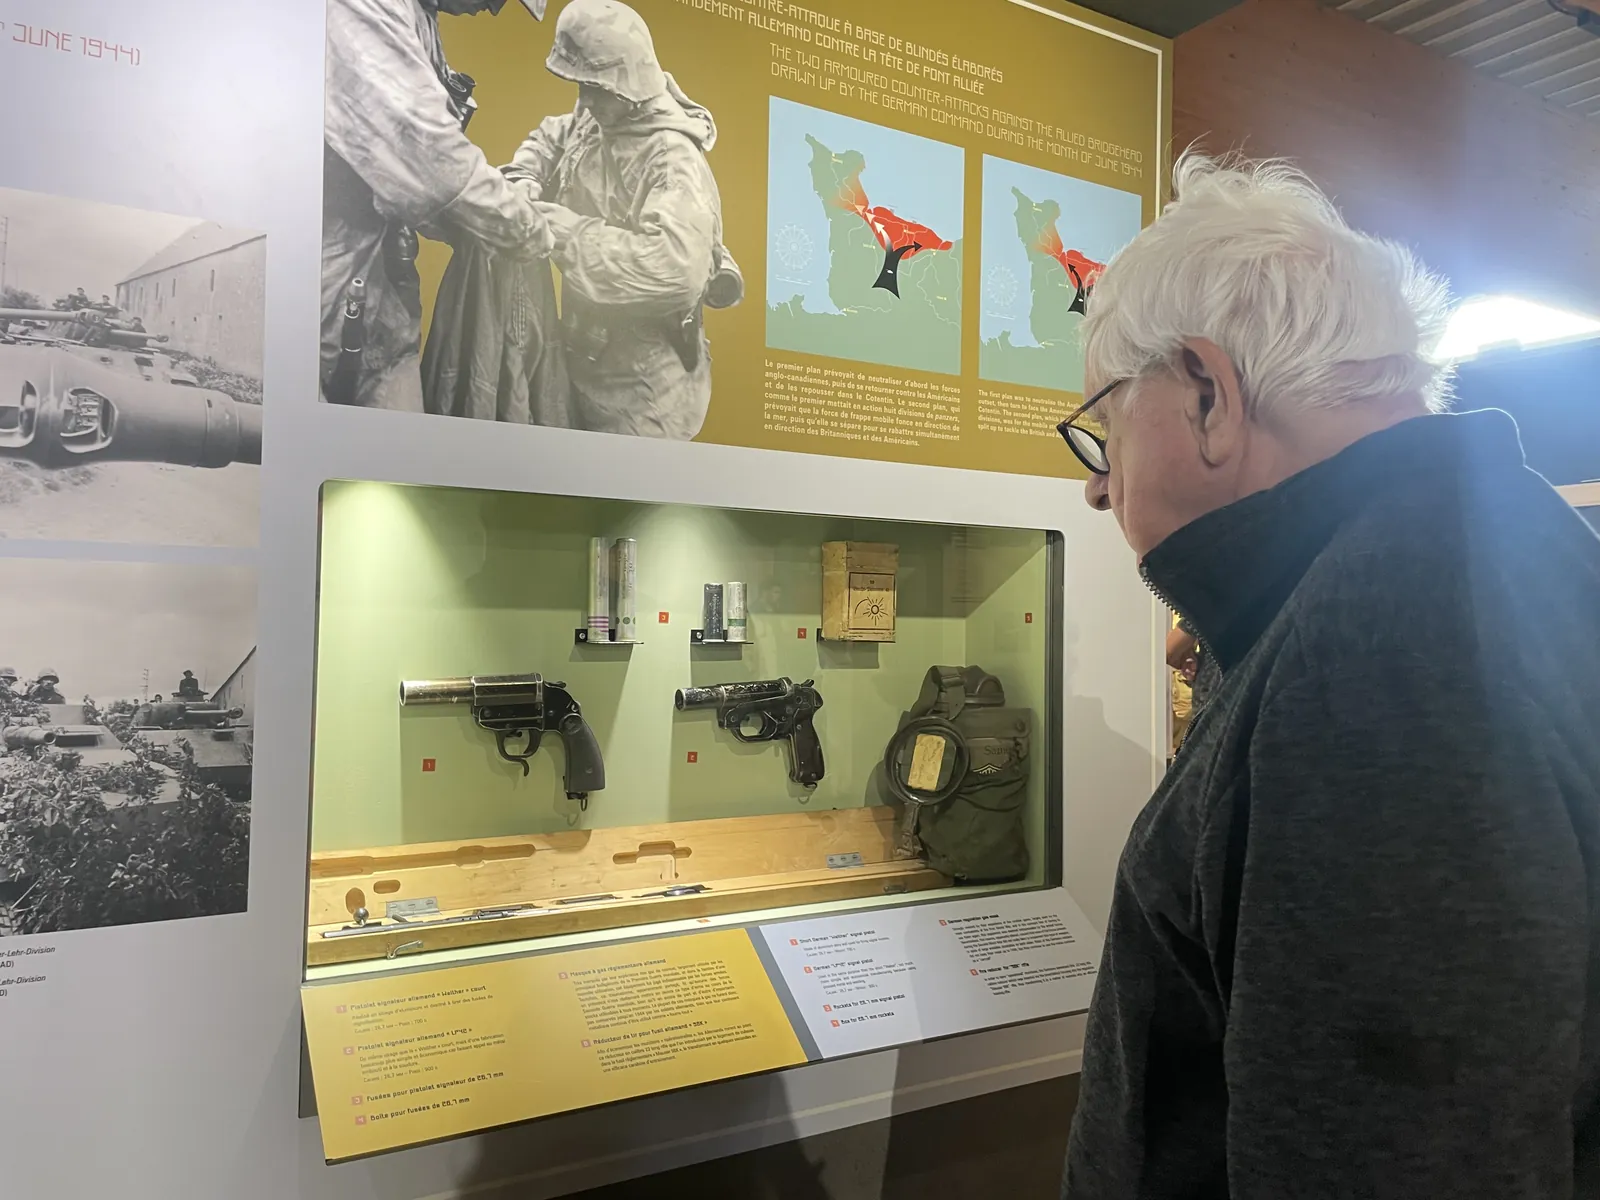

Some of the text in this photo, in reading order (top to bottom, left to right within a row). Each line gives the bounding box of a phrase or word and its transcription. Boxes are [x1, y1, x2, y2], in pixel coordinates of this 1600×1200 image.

[12, 22, 140, 66] JUNE 1944)
[748, 11, 811, 43] ALLEMAND
[816, 32, 860, 58] CONTRE
[863, 46, 877, 63] LA
[880, 51, 903, 71] TÊTE
[906, 60, 920, 76] DE
[923, 65, 951, 85] PONT
[953, 75, 985, 96] ALLIÉE
[844, 20, 852, 36] À
[856, 25, 885, 47] BASE
[888, 36, 903, 52] DE
[905, 41, 949, 67] BLINDÉS
[952, 54, 1003, 84] ÉLABORÉS
[769, 42, 1143, 164] THE TWO ARMOURED COUNTER-ATTACKS AGAINST THE ALLIED BRIDGEHEAD
[771, 62, 1143, 179] DRAWN UP BY THE GERMAN COMMAND DURING THE MONTH OF JUNE 1944
[764, 371, 831, 387] anglo-canadiennes,
[832, 380, 847, 389] puis
[847, 382, 856, 390] de
[865, 385, 895, 395] retourner
[896, 388, 916, 398] contre
[917, 390, 926, 399] les
[926, 391, 961, 403] Américains
[765, 359, 961, 394] Le premier plan prévoyait de neutraliser d'abord les forces
[764, 381, 773, 389] et
[787, 383, 798, 392] les
[801, 386, 835, 397] repousser
[837, 390, 853, 399] dans
[856, 392, 863, 400] le
[865, 393, 895, 405] Cotentin.
[897, 398, 906, 406] Le
[908, 400, 930, 409] second
[932, 403, 948, 412] plan,
[950, 405, 961, 414] qui
[764, 392, 790, 401] comme
[791, 394, 798, 402] le
[800, 396, 826, 406] premier
[827, 400, 852, 409] mettait
[862, 404, 883, 413] action
[883, 406, 897, 415] huit
[897, 408, 925, 419] divisions
[926, 412, 934, 420] de
[934, 414, 960, 423] panzers,
[764, 402, 797, 413] prévoyait
[798, 407, 812, 417] que
[812, 406, 820, 415] la
[821, 408, 839, 417] force
[840, 411, 849, 419] de
[850, 411, 872, 422] frappe
[872, 415, 894, 424] mobile
[895, 417, 914, 426] fonce
[923, 421, 952, 431] direction
[952, 424, 960, 432] de
[764, 411, 771, 420] la
[772, 414, 788, 422] mer,
[790, 415, 805, 424] puis
[806, 417, 829, 427] qu'elle
[839, 420, 862, 430] sépare
[863, 424, 878, 432] pour
[888, 427, 914, 436] rabattre
[774, 424, 806, 435] direction
[806, 427, 819, 436] des
[820, 428, 862, 441] Britanniques
[870, 434, 882, 442] des
[883, 436, 920, 447] Américains.
